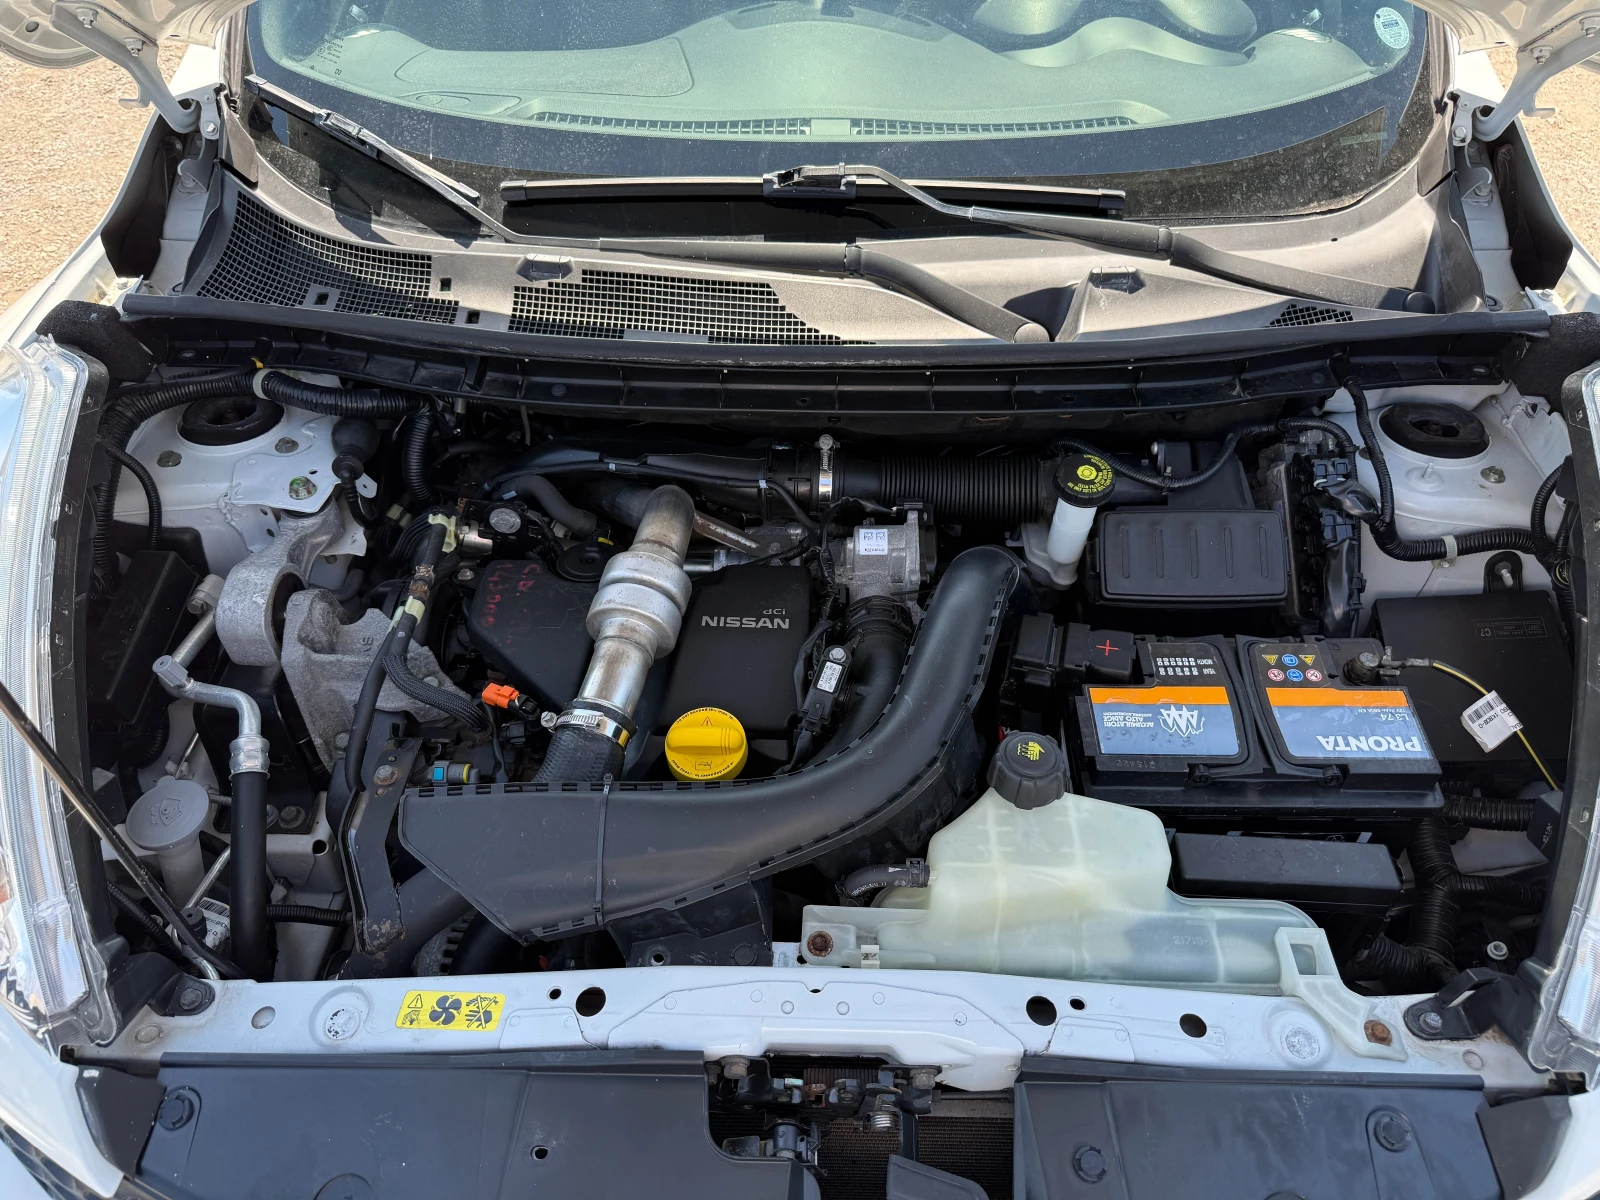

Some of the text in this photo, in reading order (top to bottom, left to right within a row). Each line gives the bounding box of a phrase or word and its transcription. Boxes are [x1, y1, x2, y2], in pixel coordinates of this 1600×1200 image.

[701, 615, 790, 629] NISSAN
[1380, 713, 1409, 721] L3 74
[1315, 735, 1423, 752] PRONTA
